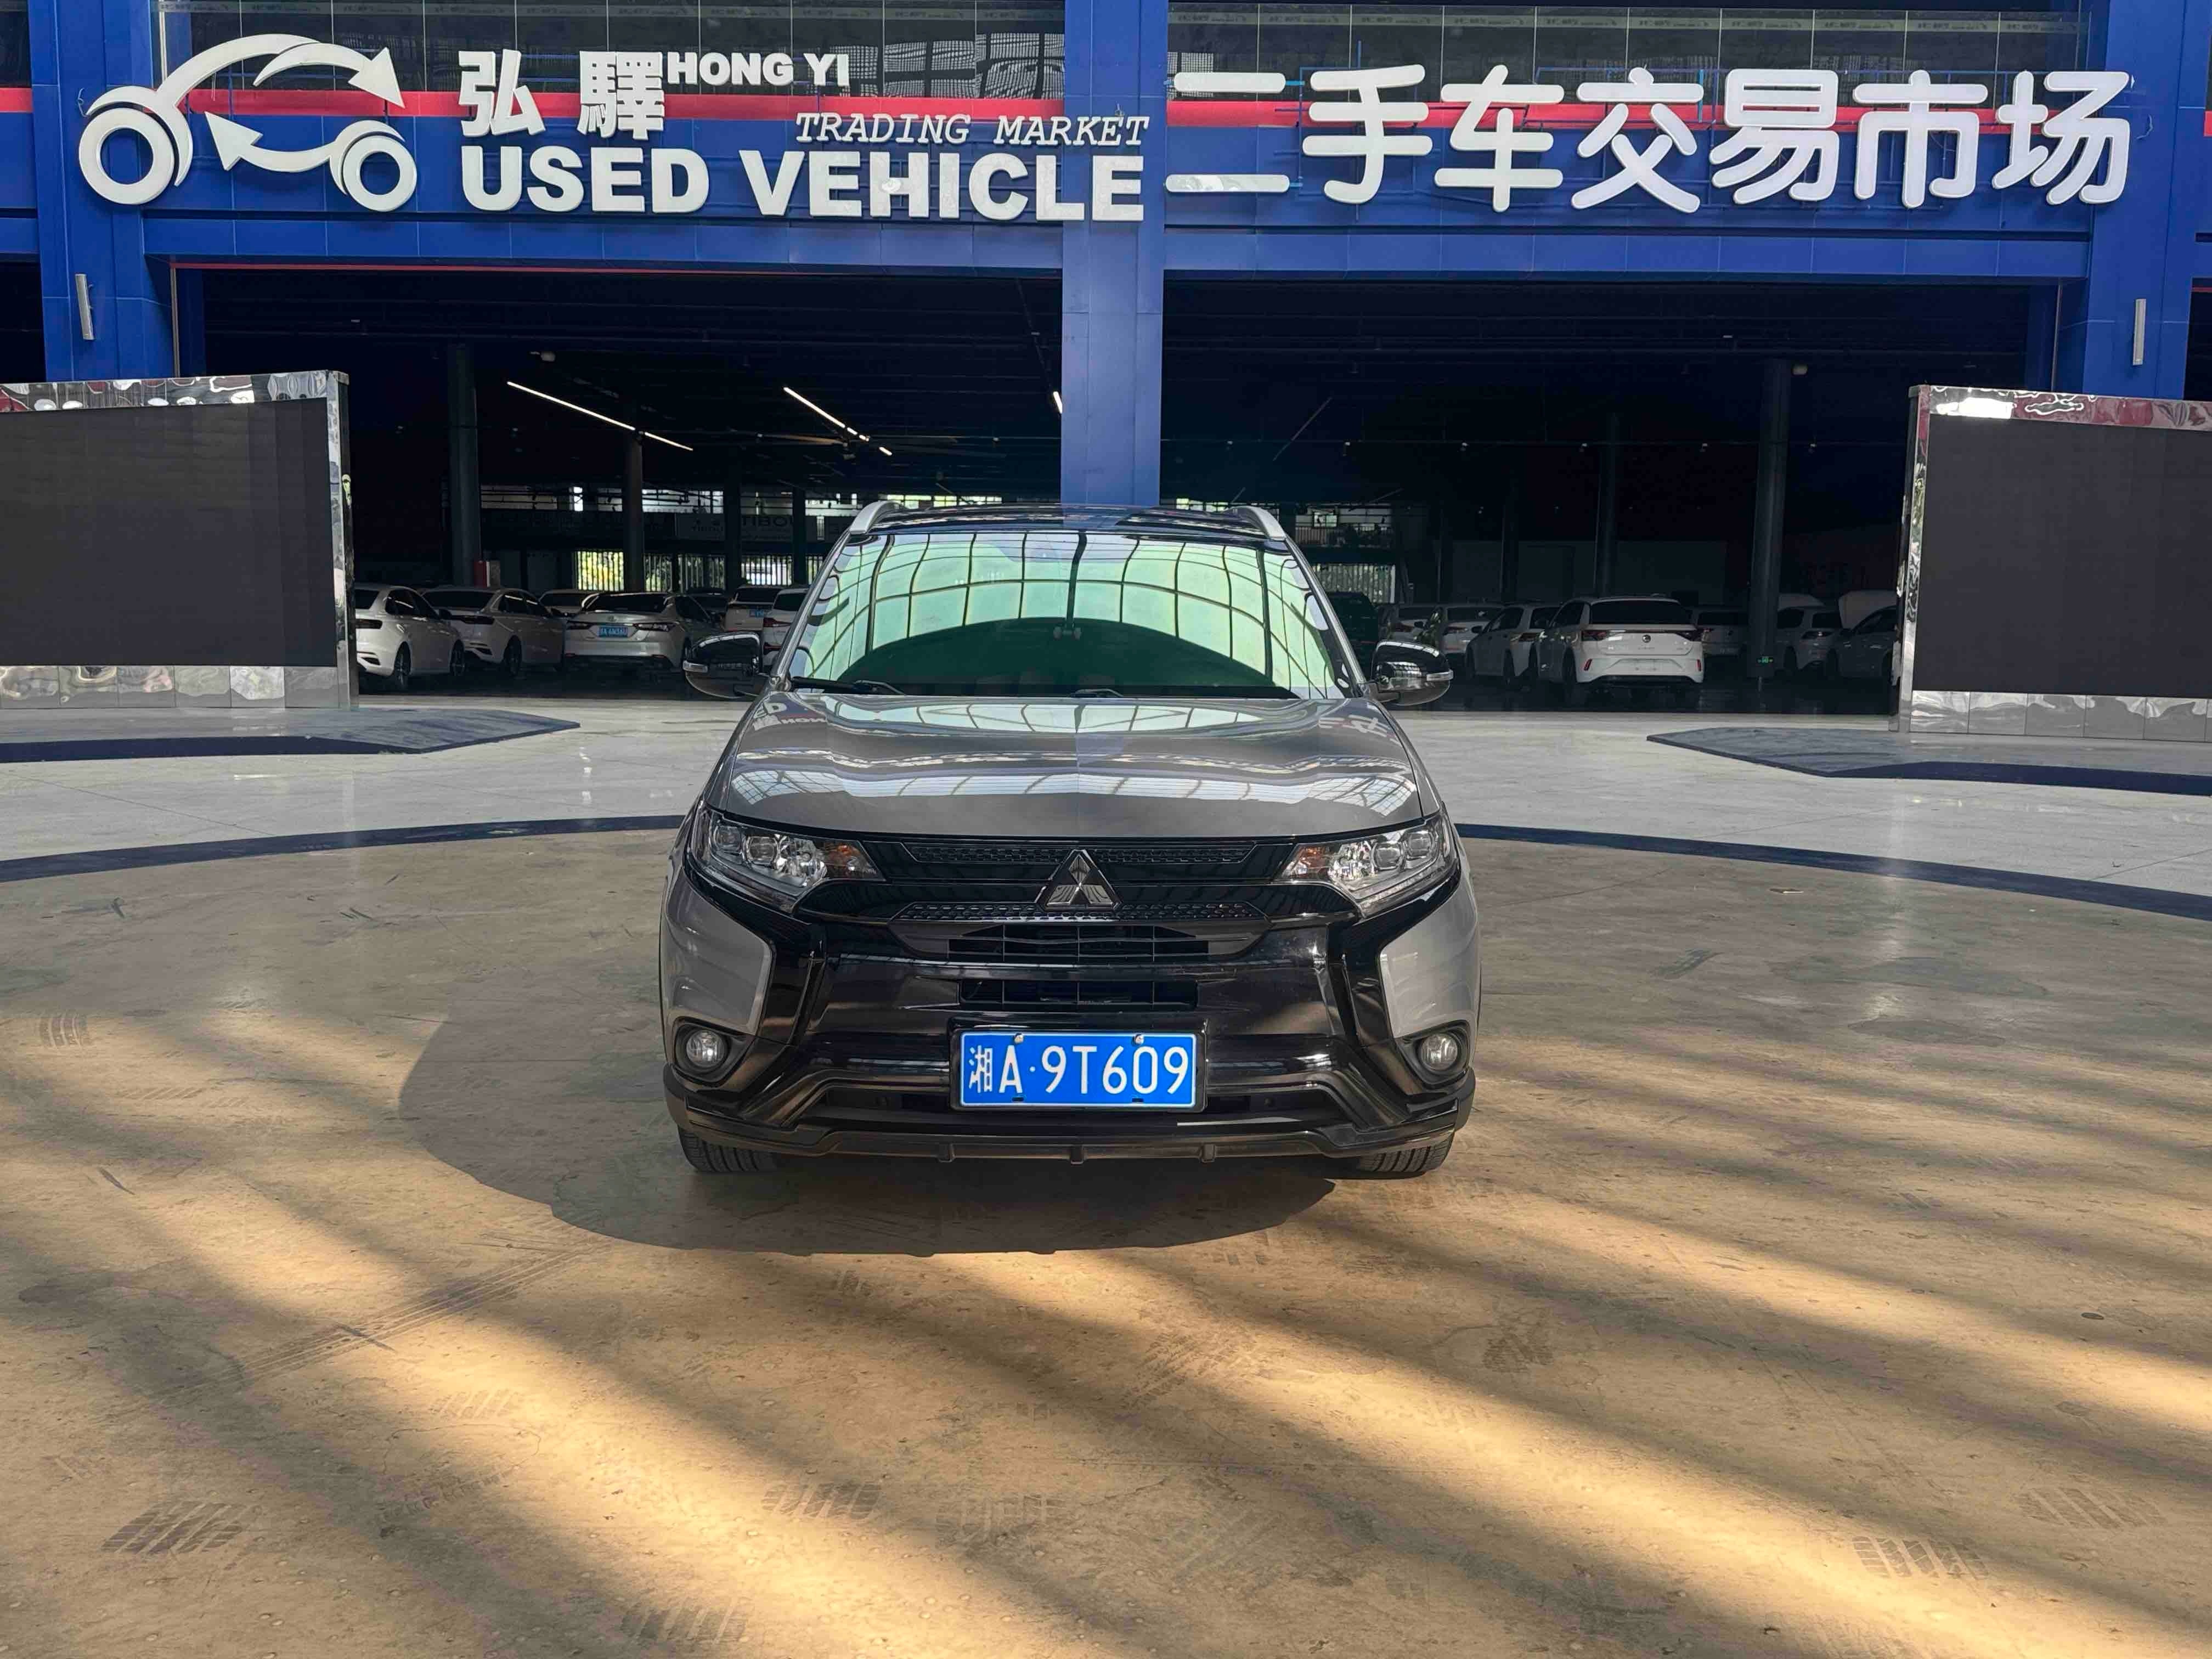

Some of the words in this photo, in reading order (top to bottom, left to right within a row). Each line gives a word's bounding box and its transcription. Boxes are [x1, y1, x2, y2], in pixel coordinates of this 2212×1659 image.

[668, 51, 794, 86] HONG
[803, 53, 849, 86] YI
[795, 112, 972, 144] TRADING
[993, 115, 1150, 146] MARKET
[1165, 64, 2131, 213] 二手车交易市场
[460, 145, 710, 213] USED
[738, 149, 1145, 221] VEHICLE
[969, 1044, 1189, 1095] 湘A·9T609
